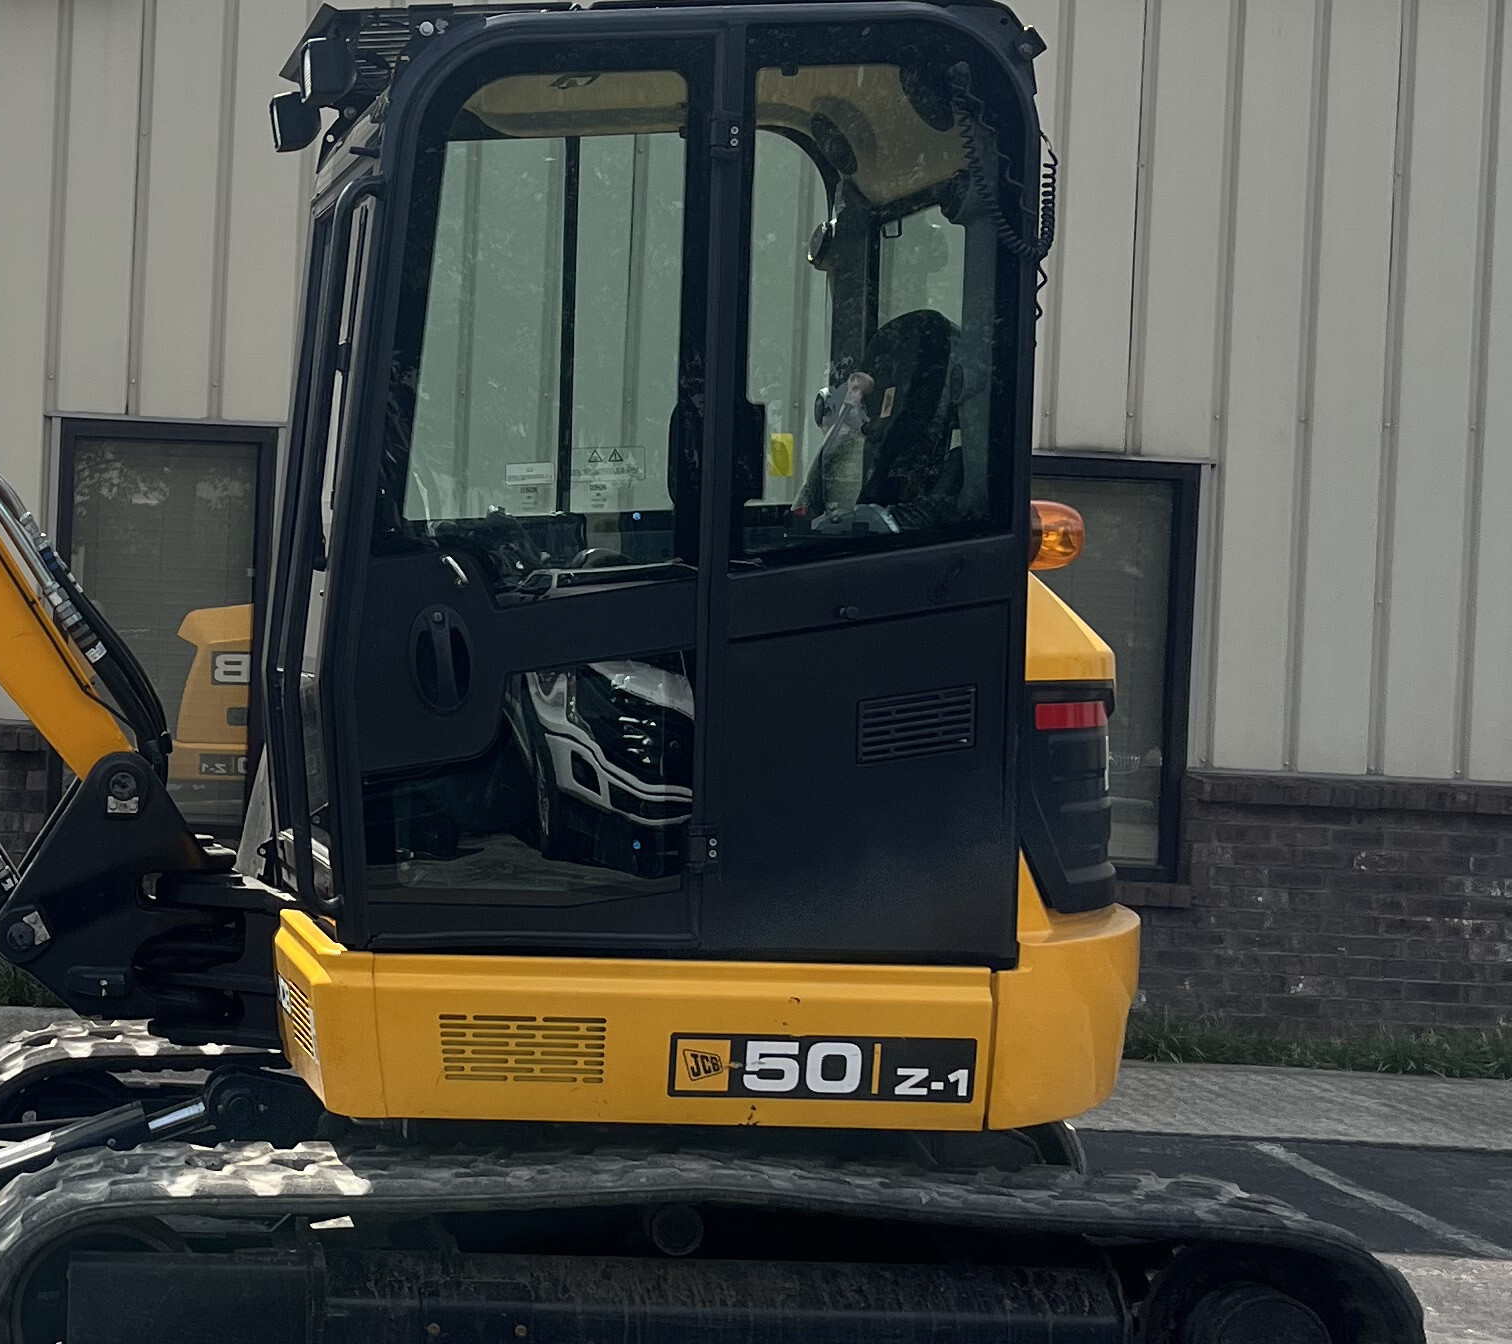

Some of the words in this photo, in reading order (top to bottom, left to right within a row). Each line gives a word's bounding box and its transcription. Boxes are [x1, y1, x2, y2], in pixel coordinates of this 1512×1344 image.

[689, 1053, 720, 1077] JCB
[743, 1040, 862, 1094] 50
[894, 1068, 969, 1096] Z-1
